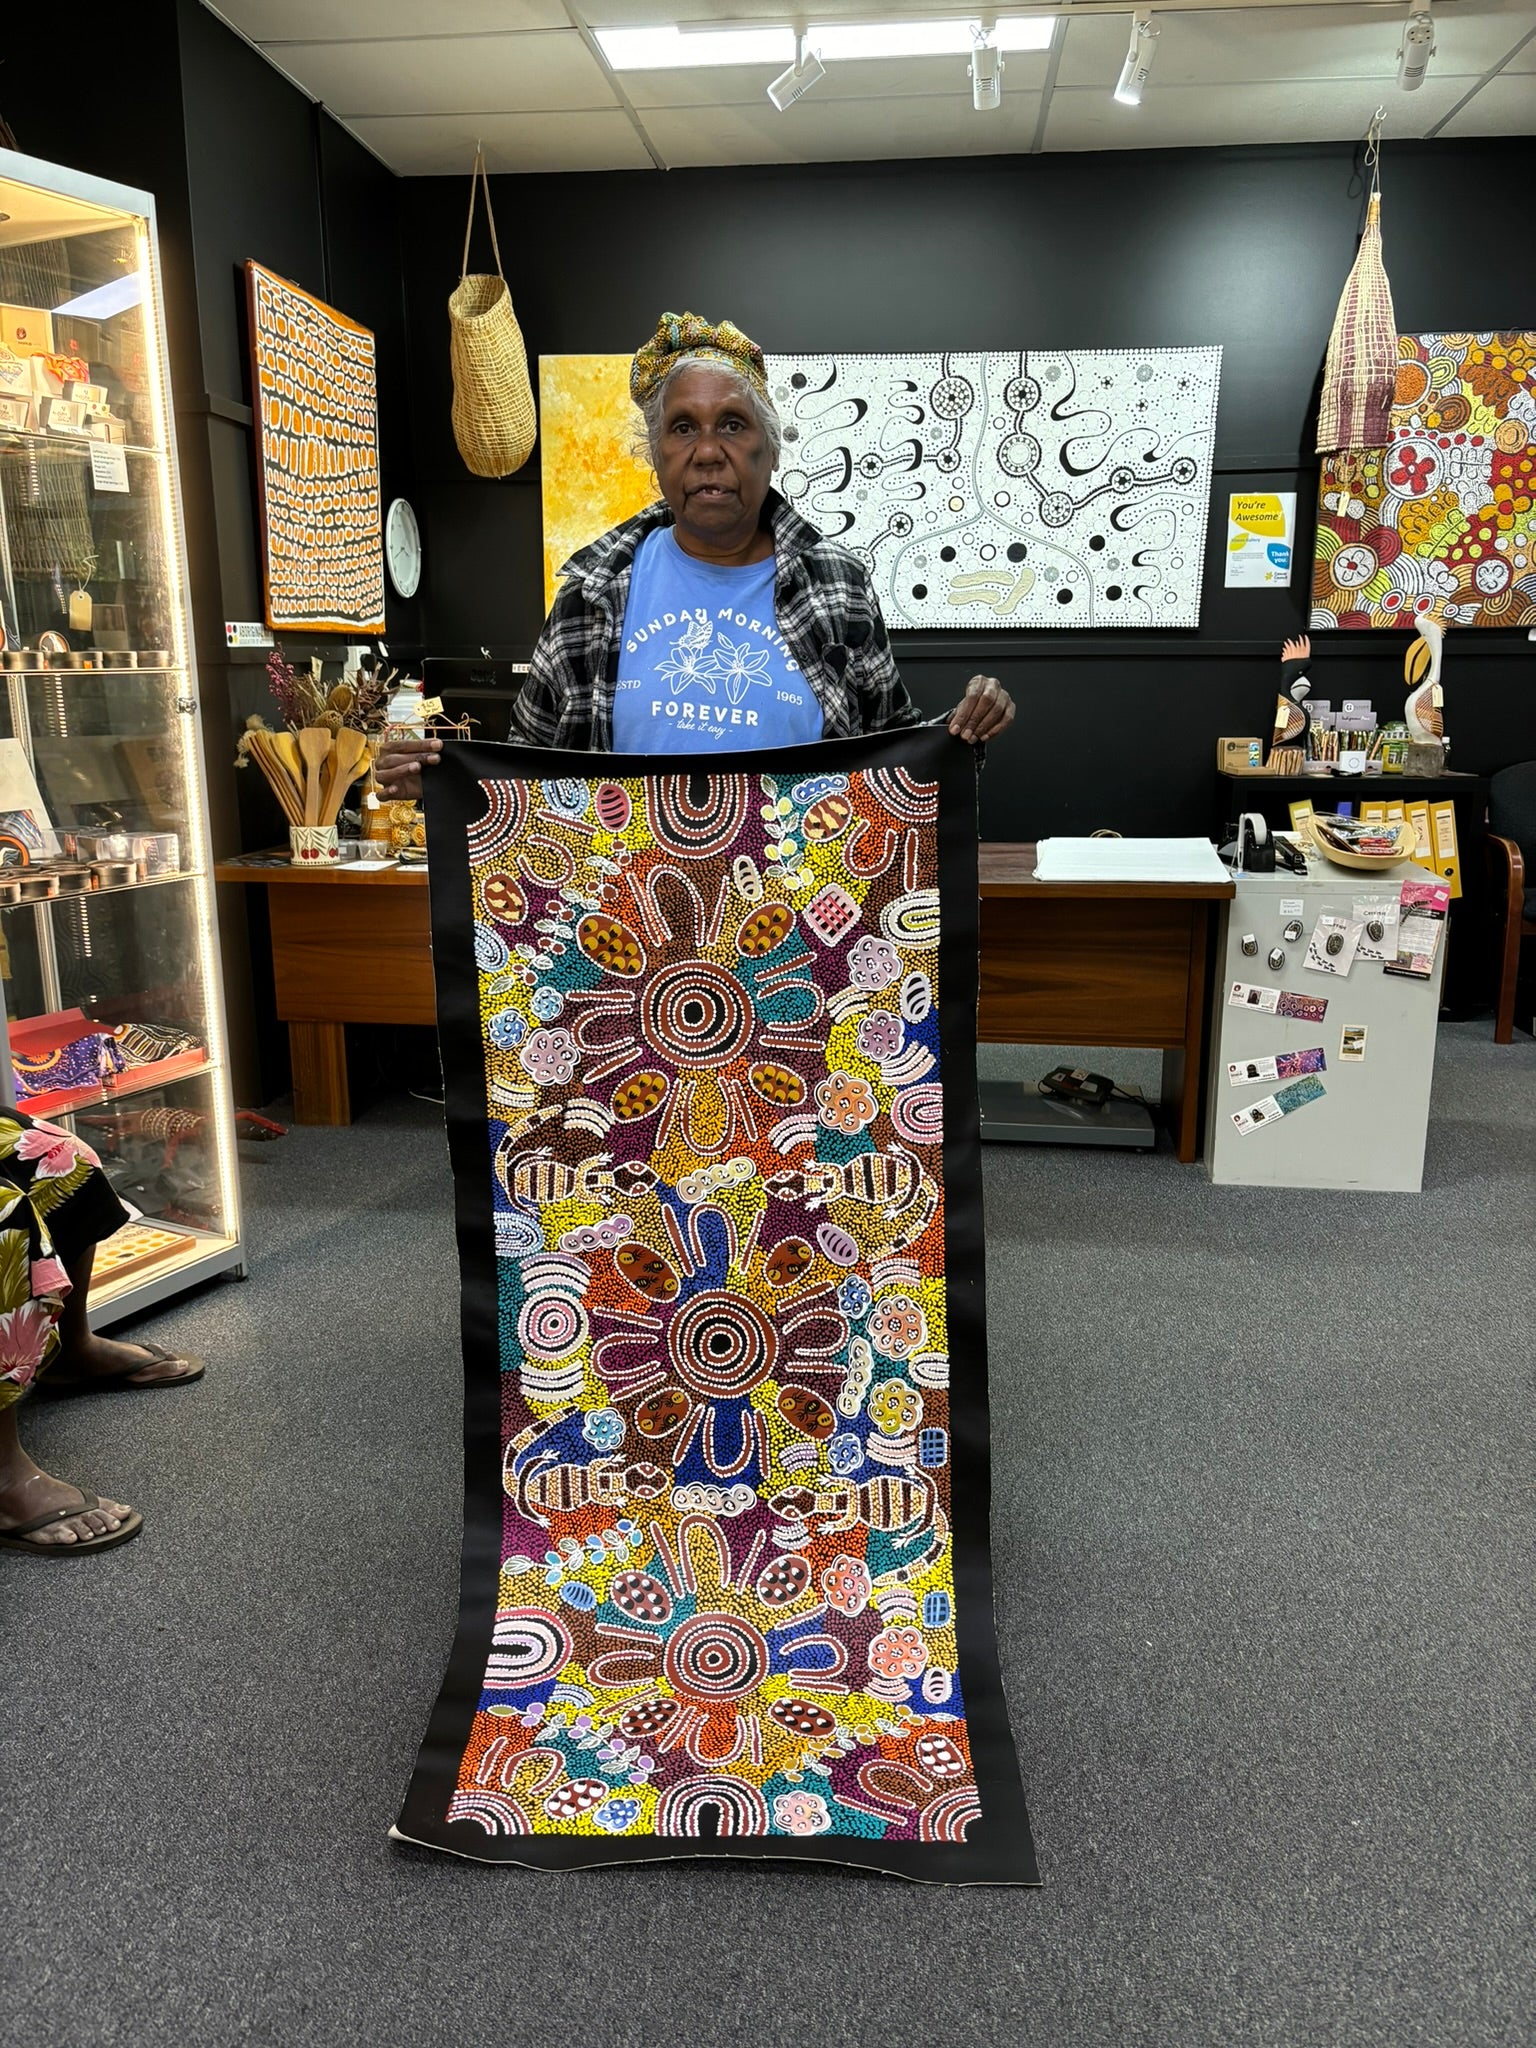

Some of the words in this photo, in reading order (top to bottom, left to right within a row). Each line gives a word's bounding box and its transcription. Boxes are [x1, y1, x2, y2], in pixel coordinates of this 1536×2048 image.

[1237, 500, 1266, 509] You're
[1235, 513, 1279, 521] Awesome
[626, 608, 707, 653] SUNDAY
[776, 689, 803, 706] 1965
[652, 701, 759, 727] FOREVER
[675, 718, 697, 732] take
[698, 722, 709, 733] it
[709, 723, 726, 740] easy
